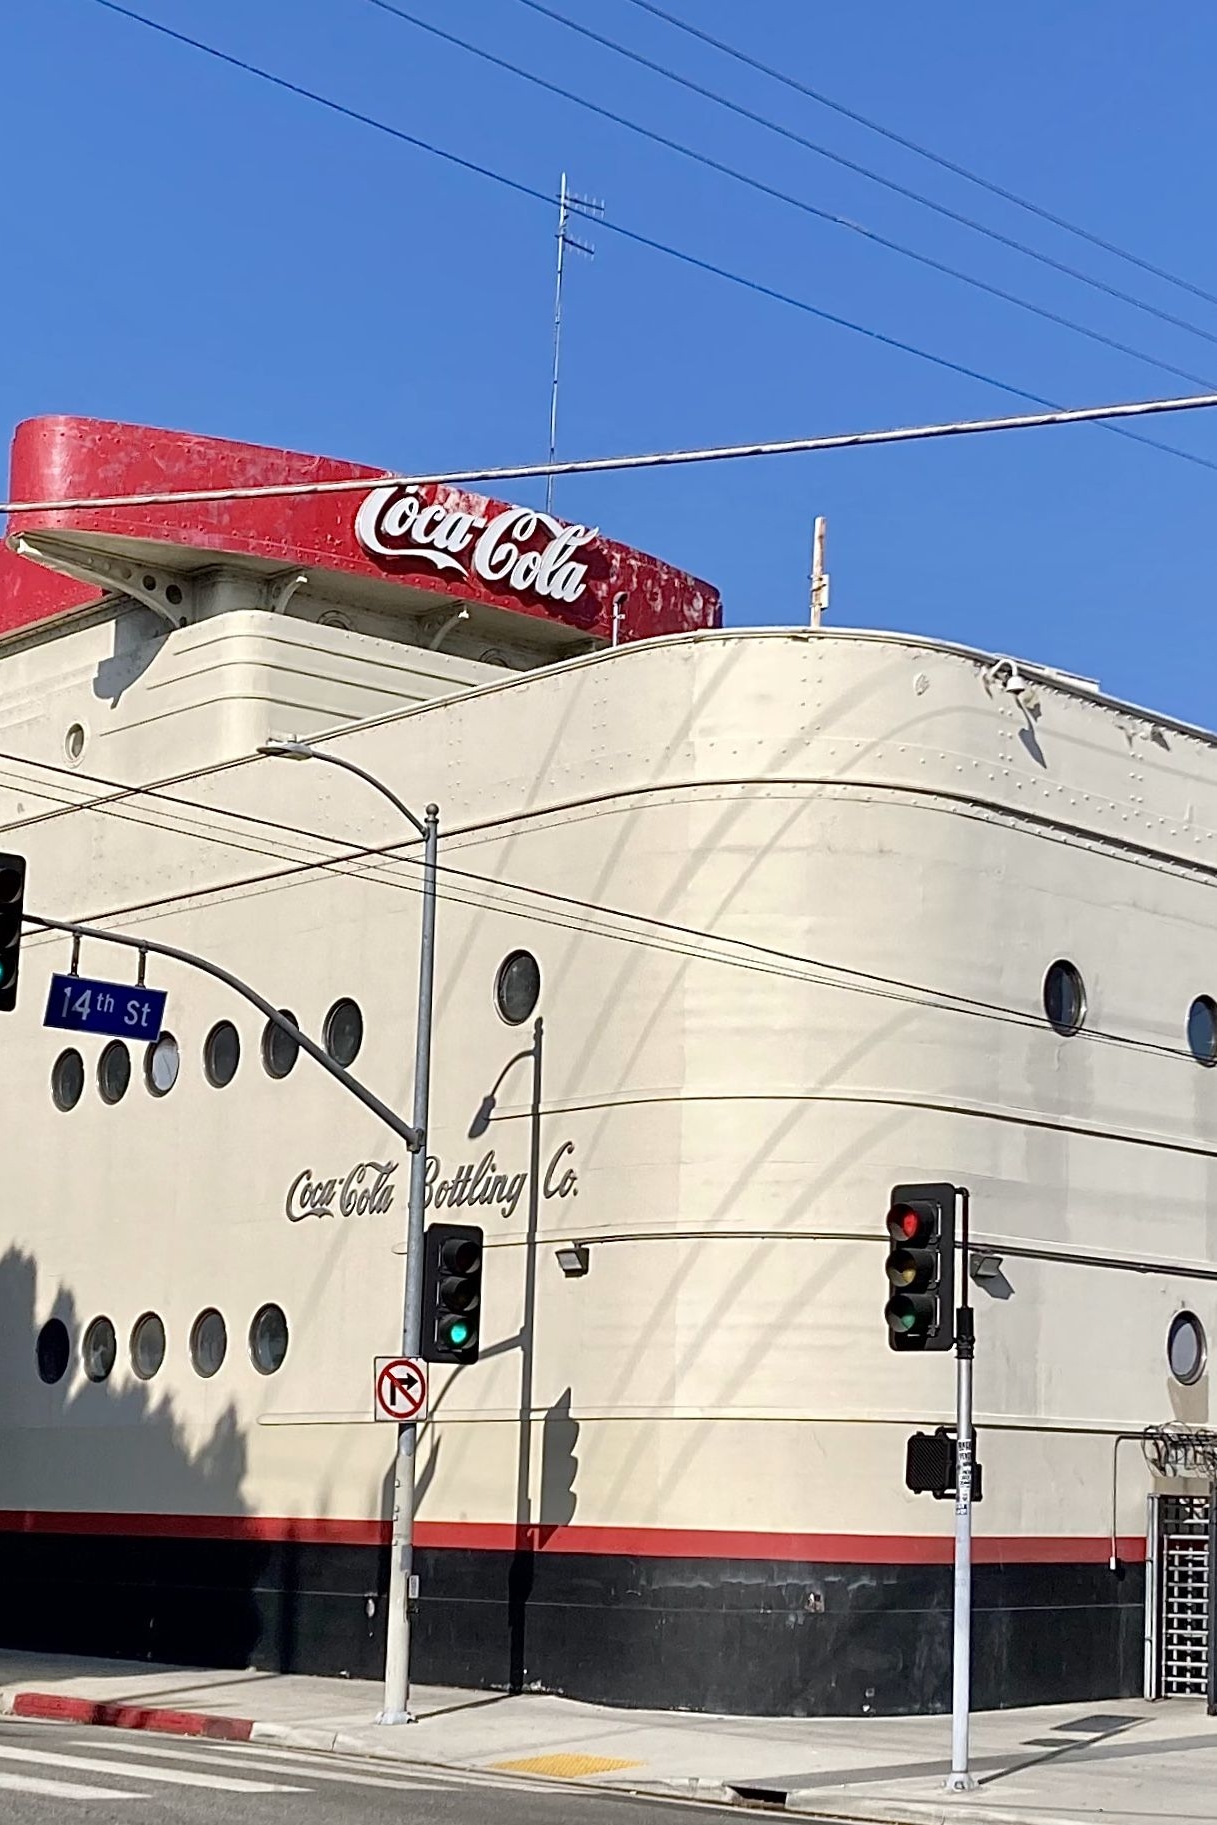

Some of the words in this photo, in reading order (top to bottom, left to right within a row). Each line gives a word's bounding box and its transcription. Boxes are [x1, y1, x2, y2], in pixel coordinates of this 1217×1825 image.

[355, 485, 599, 602] Coca-Cola
[62, 987, 114, 1020] 14th
[124, 1000, 151, 1027] St
[286, 1160, 399, 1222] Coca-Cola
[424, 1149, 528, 1218] Bottling
[543, 1140, 579, 1199] Co.
